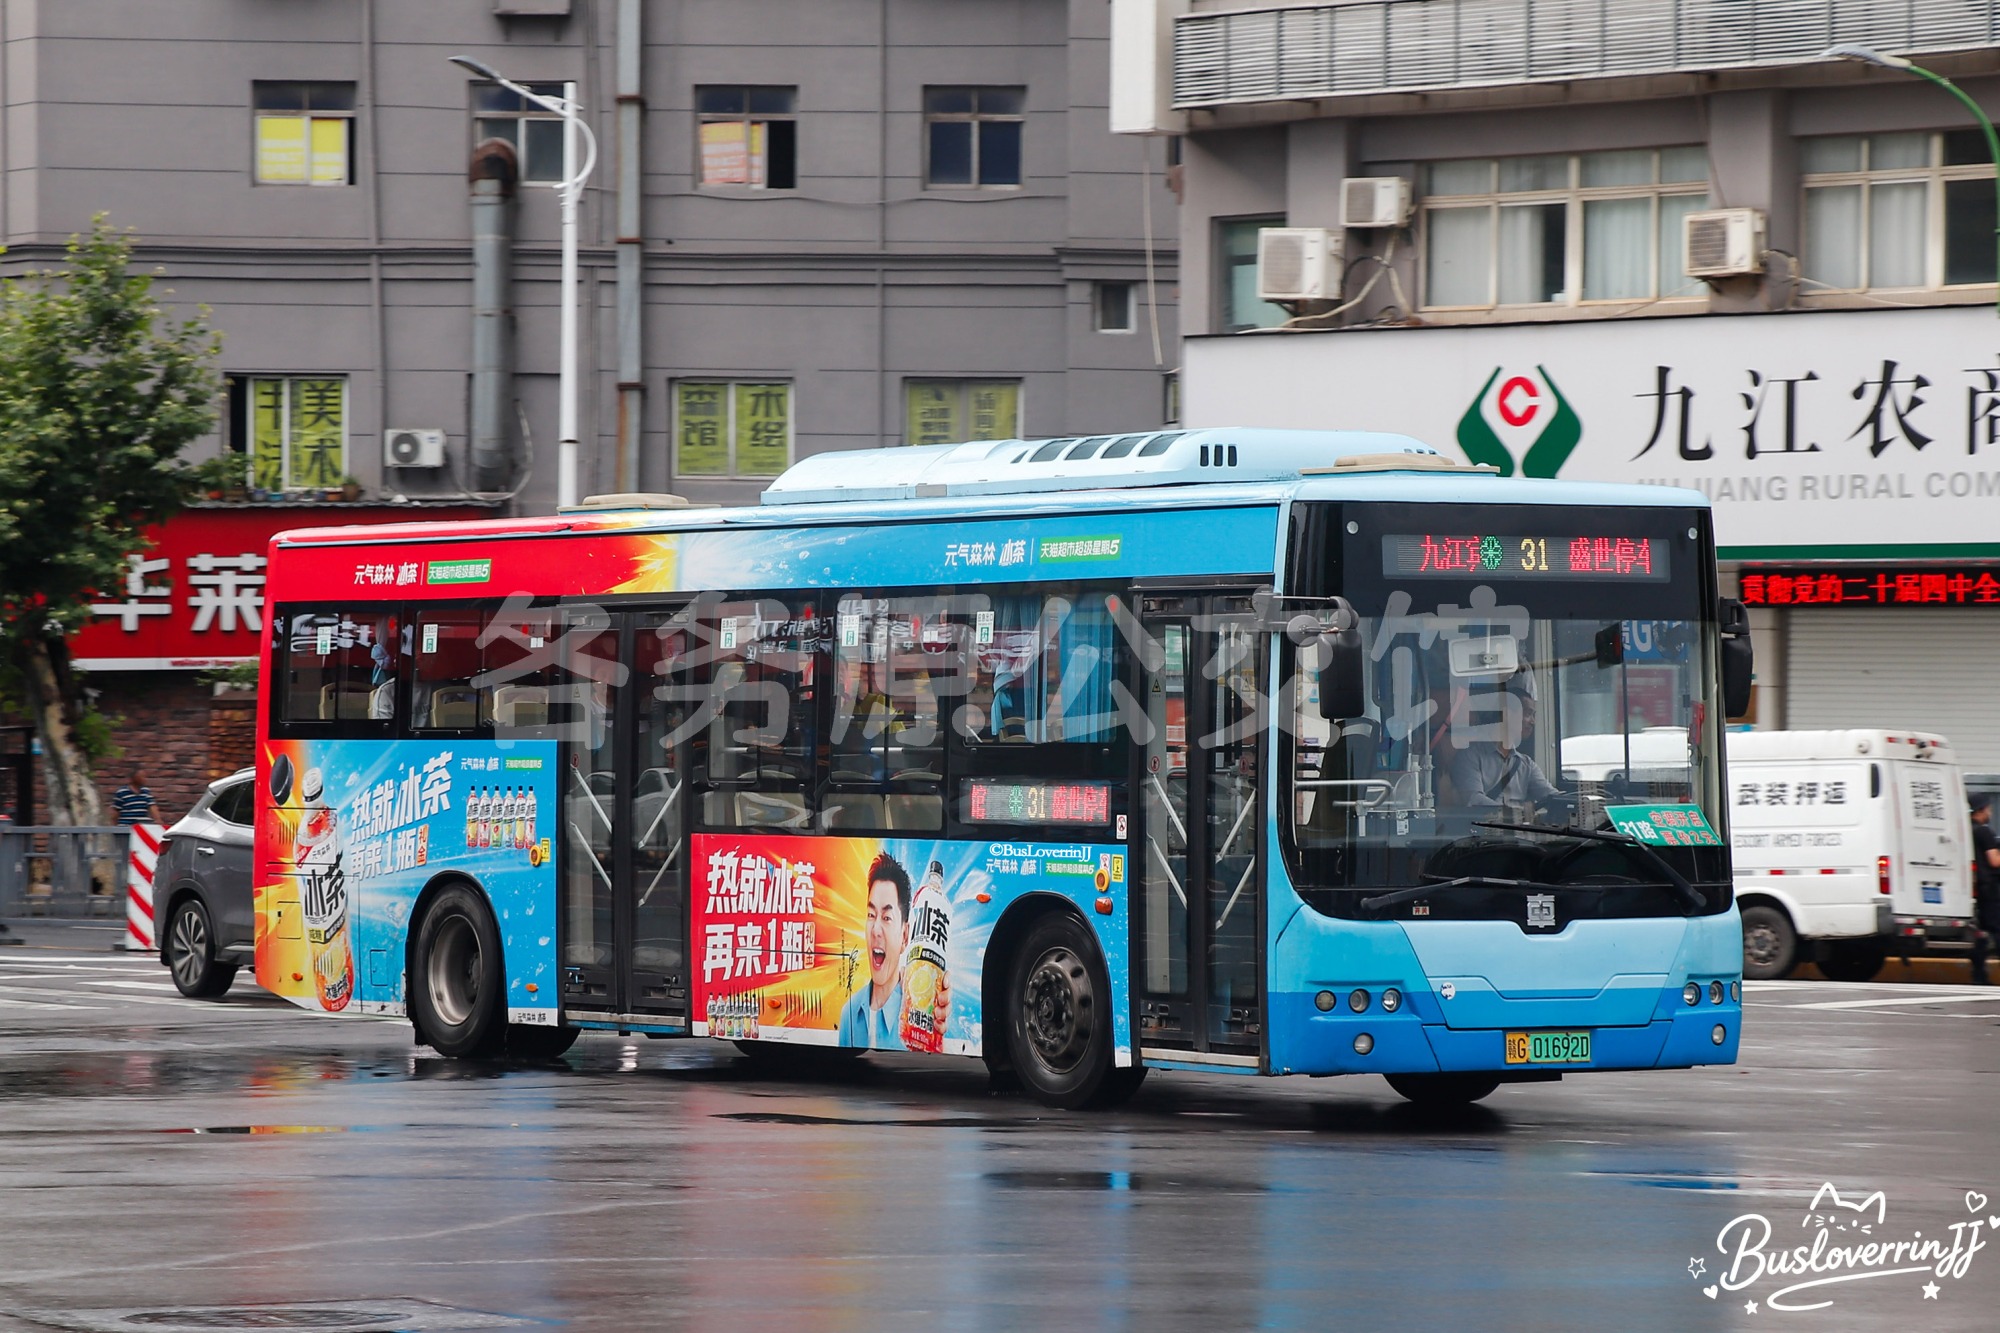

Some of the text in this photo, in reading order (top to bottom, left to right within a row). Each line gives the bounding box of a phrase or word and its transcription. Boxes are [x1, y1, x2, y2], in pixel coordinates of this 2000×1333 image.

[303, 382, 342, 484] 美术
[1801, 473, 1914, 500] RURAL
[945, 542, 996, 566] 元气森林
[1040, 539, 1120, 559] 天猫超市超级星期5
[1520, 538, 1549, 571] 31
[354, 563, 395, 585] 元气森林
[350, 751, 453, 845] 热就冰茶
[1027, 787, 1046, 818] 31
[1619, 820, 1659, 839] 31路
[350, 827, 417, 882] 再来1瓶
[986, 858, 1019, 875] 元气森林
[705, 846, 816, 915] 热就冰茶
[911, 901, 951, 952] 冰茶
[703, 918, 804, 983] 再来1瓶
